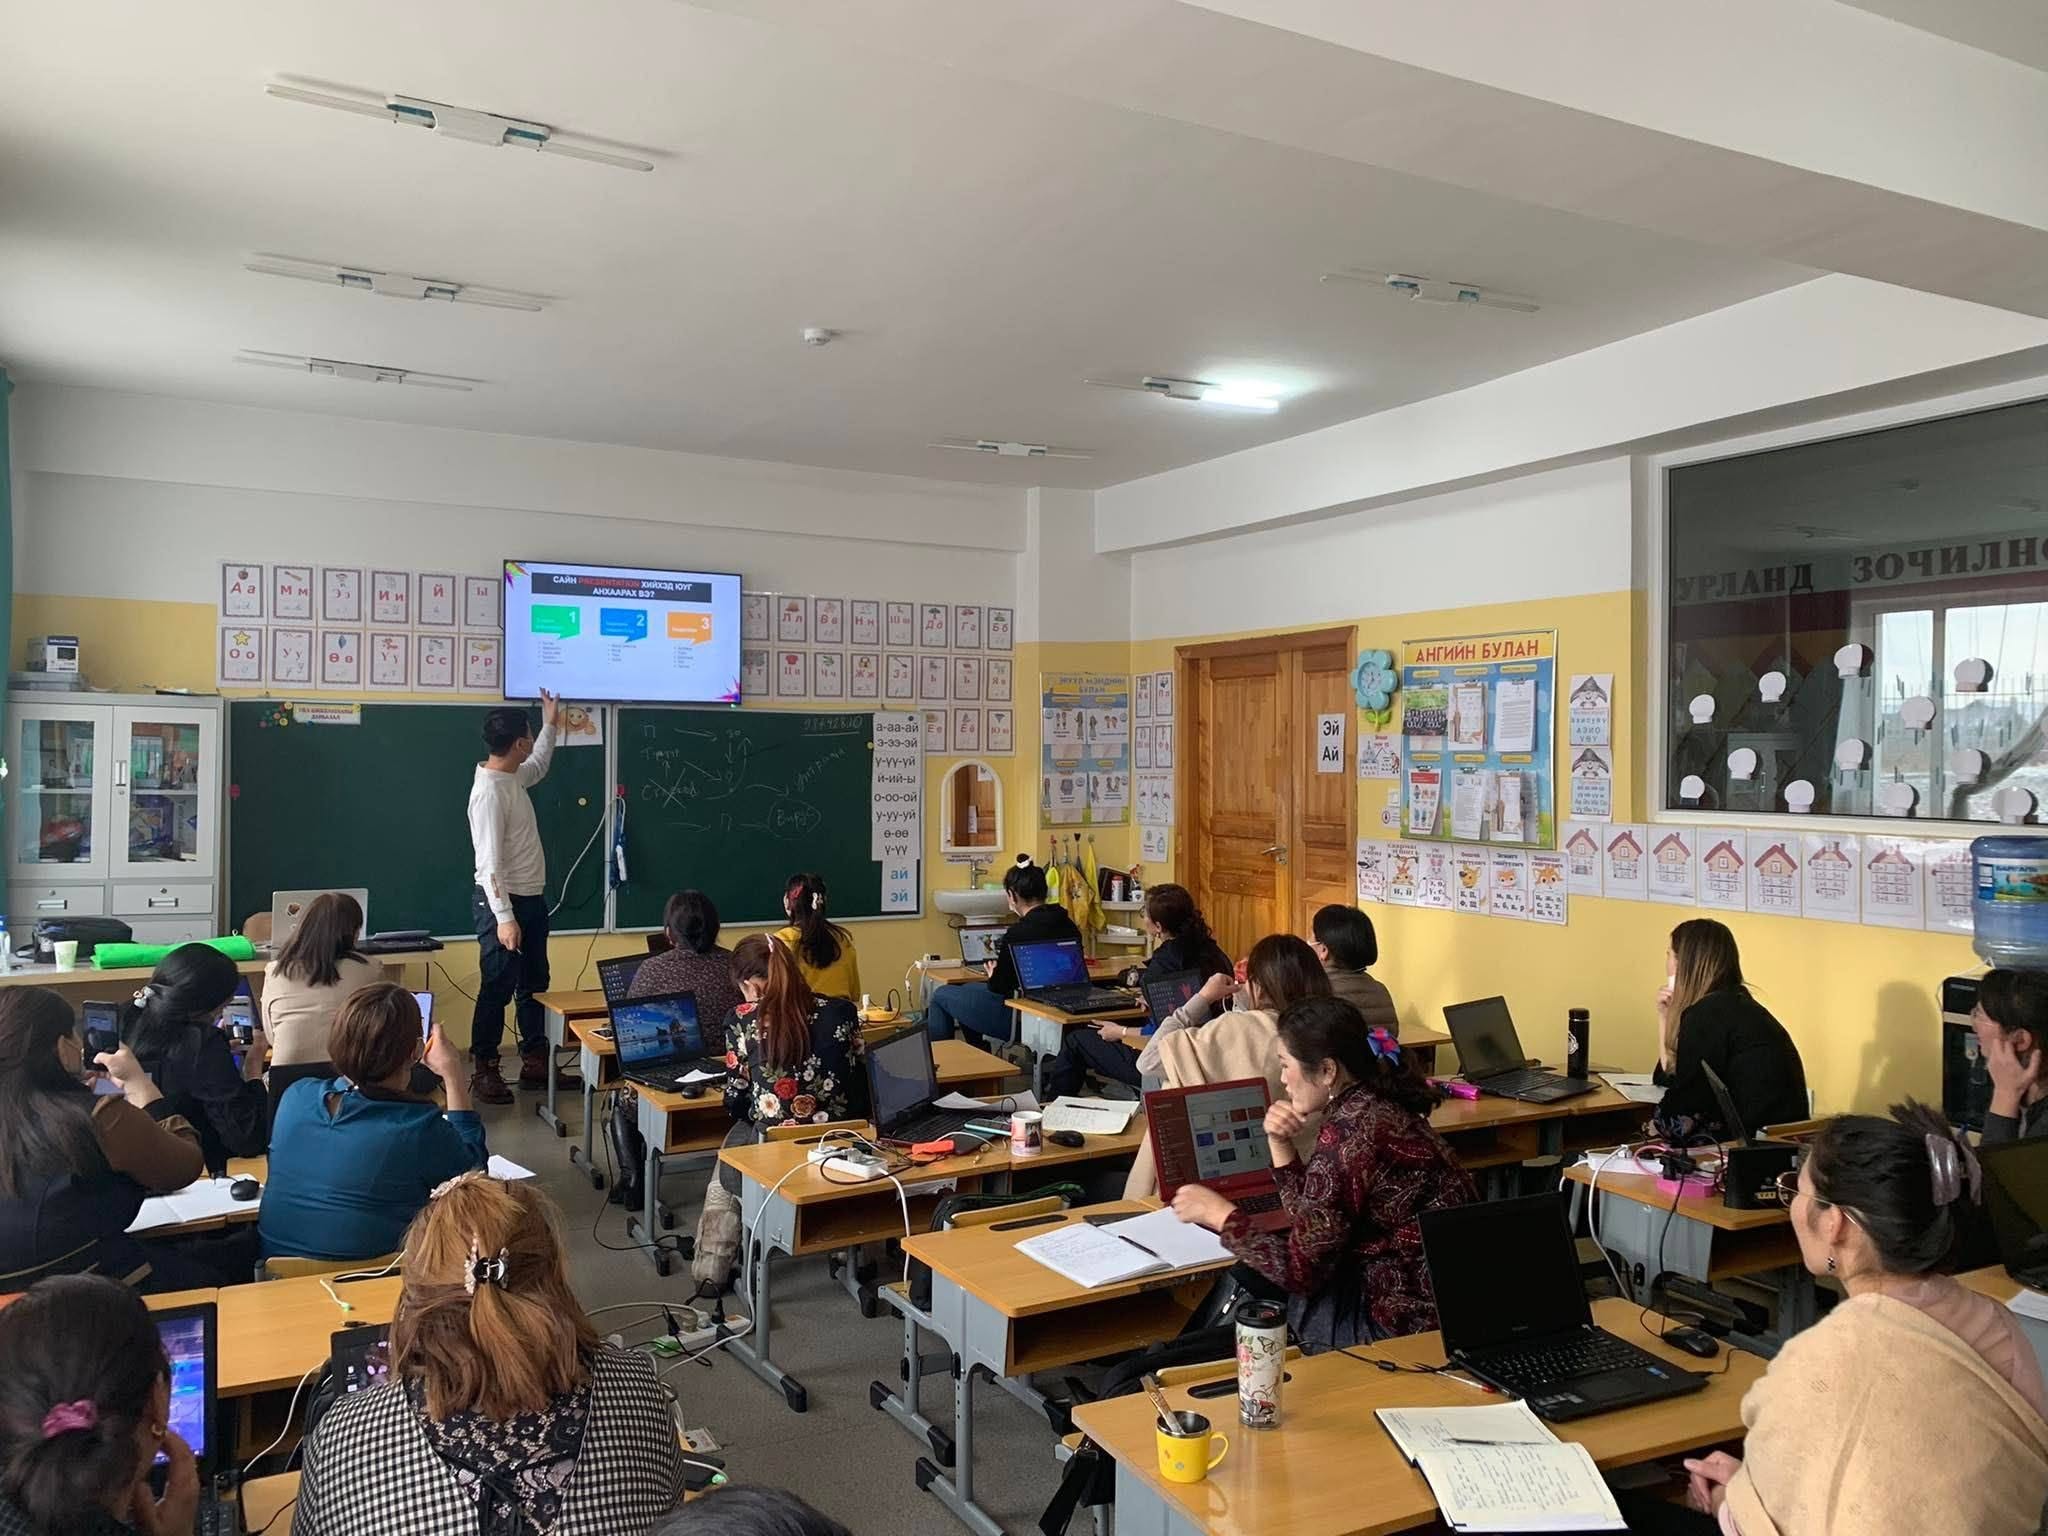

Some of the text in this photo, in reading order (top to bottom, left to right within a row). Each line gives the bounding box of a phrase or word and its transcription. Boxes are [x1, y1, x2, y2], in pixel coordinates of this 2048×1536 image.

[553, 575, 577, 584] САЙН
[641, 581, 674, 591] ХИЙХЭД
[592, 588, 655, 598] АНХААРАХ ВЭ?
[569, 611, 576, 623] 1
[636, 614, 645, 626] 2
[701, 618, 709, 629] 3
[1416, 640, 1539, 663] АНГИЙН БУЛАН
[876, 722, 919, 732] а-аа-ай
[1323, 720, 1340, 736] Эй
[877, 738, 918, 748] э-ээ-эй
[1322, 746, 1339, 761] Ай
[875, 756, 915, 768] ү-үү-үй
[878, 773, 916, 783] и-ий-ы
[874, 792, 917, 801] о-оо-ой
[876, 809, 916, 822] у-уу-уй
[884, 829, 909, 838] ө-өө
[885, 845, 908, 856] ү-үү
[891, 867, 908, 879] ай
[891, 889, 908, 902] эй
